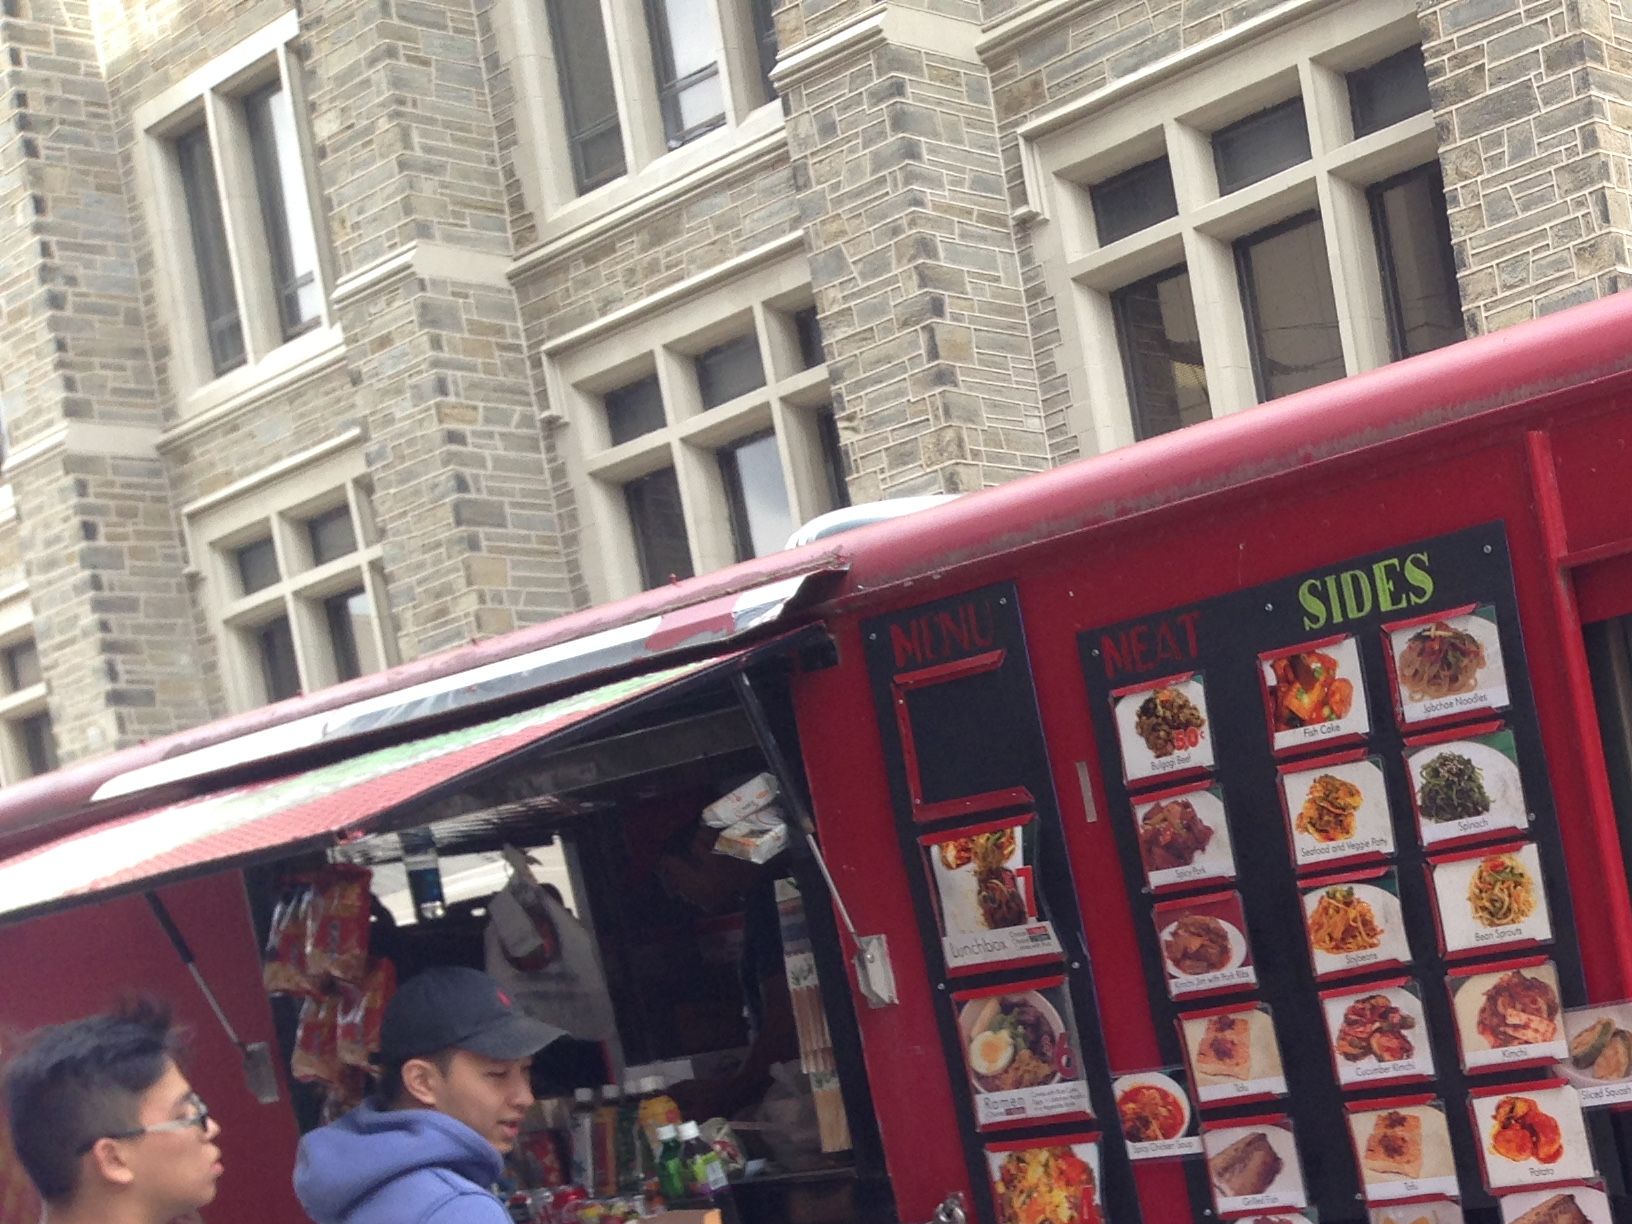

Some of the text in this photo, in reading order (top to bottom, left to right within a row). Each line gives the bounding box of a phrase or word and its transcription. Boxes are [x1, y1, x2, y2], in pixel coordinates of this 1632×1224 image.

[1299, 551, 1434, 630] SIDES
[889, 598, 996, 667] MENU
[1455, 694, 1488, 706] Noodles
[1303, 723, 1341, 738] Fish Cake
[1457, 820, 1489, 832] Spinach
[1301, 846, 1330, 858] Seafood
[1331, 842, 1345, 853] and
[1346, 839, 1371, 852] Veggie
[1475, 928, 1523, 942] Bean Sprouts
[949, 936, 1008, 959] Lunchbox
[1502, 1048, 1528, 1059] Kimchi
[1604, 1085, 1632, 1098] Squash
[1529, 1166, 1555, 1177] Potato
